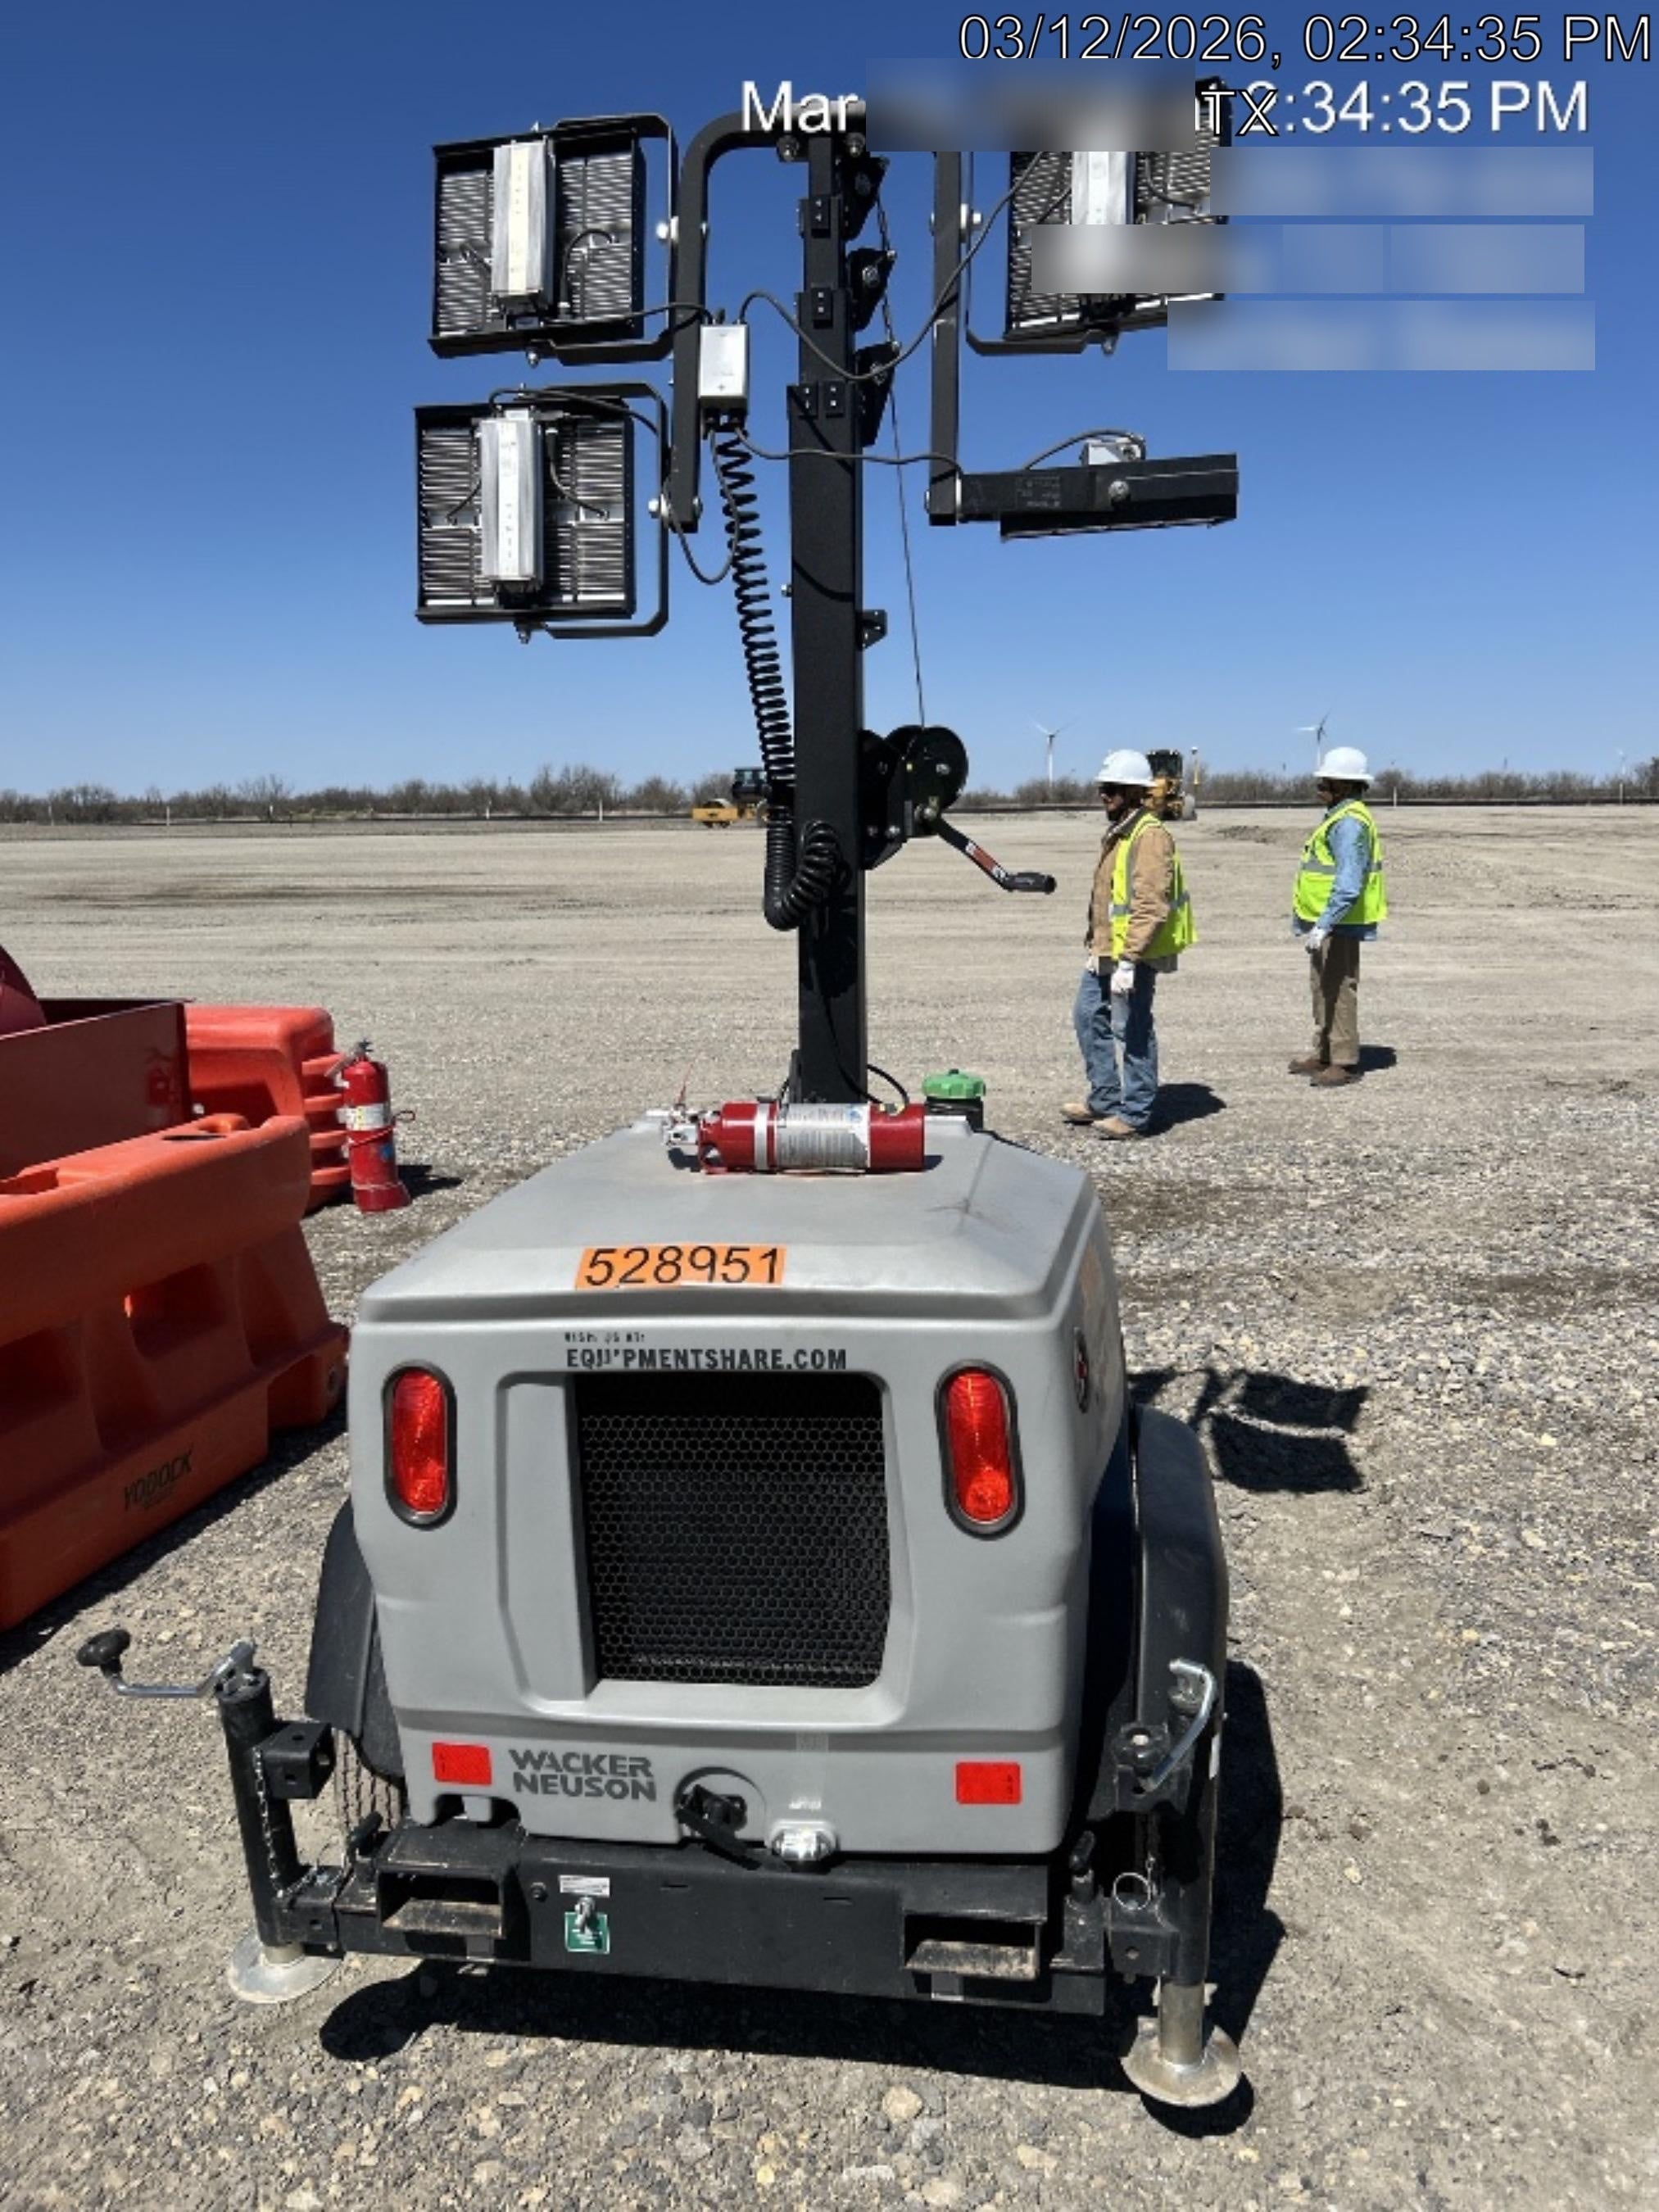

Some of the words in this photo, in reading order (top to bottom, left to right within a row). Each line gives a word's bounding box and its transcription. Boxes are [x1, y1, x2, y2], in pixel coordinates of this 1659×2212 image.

[585, 1245, 779, 1286] 528951
[508, 1749, 654, 1778] WACKER
[513, 1771, 656, 1802] NEUSON
